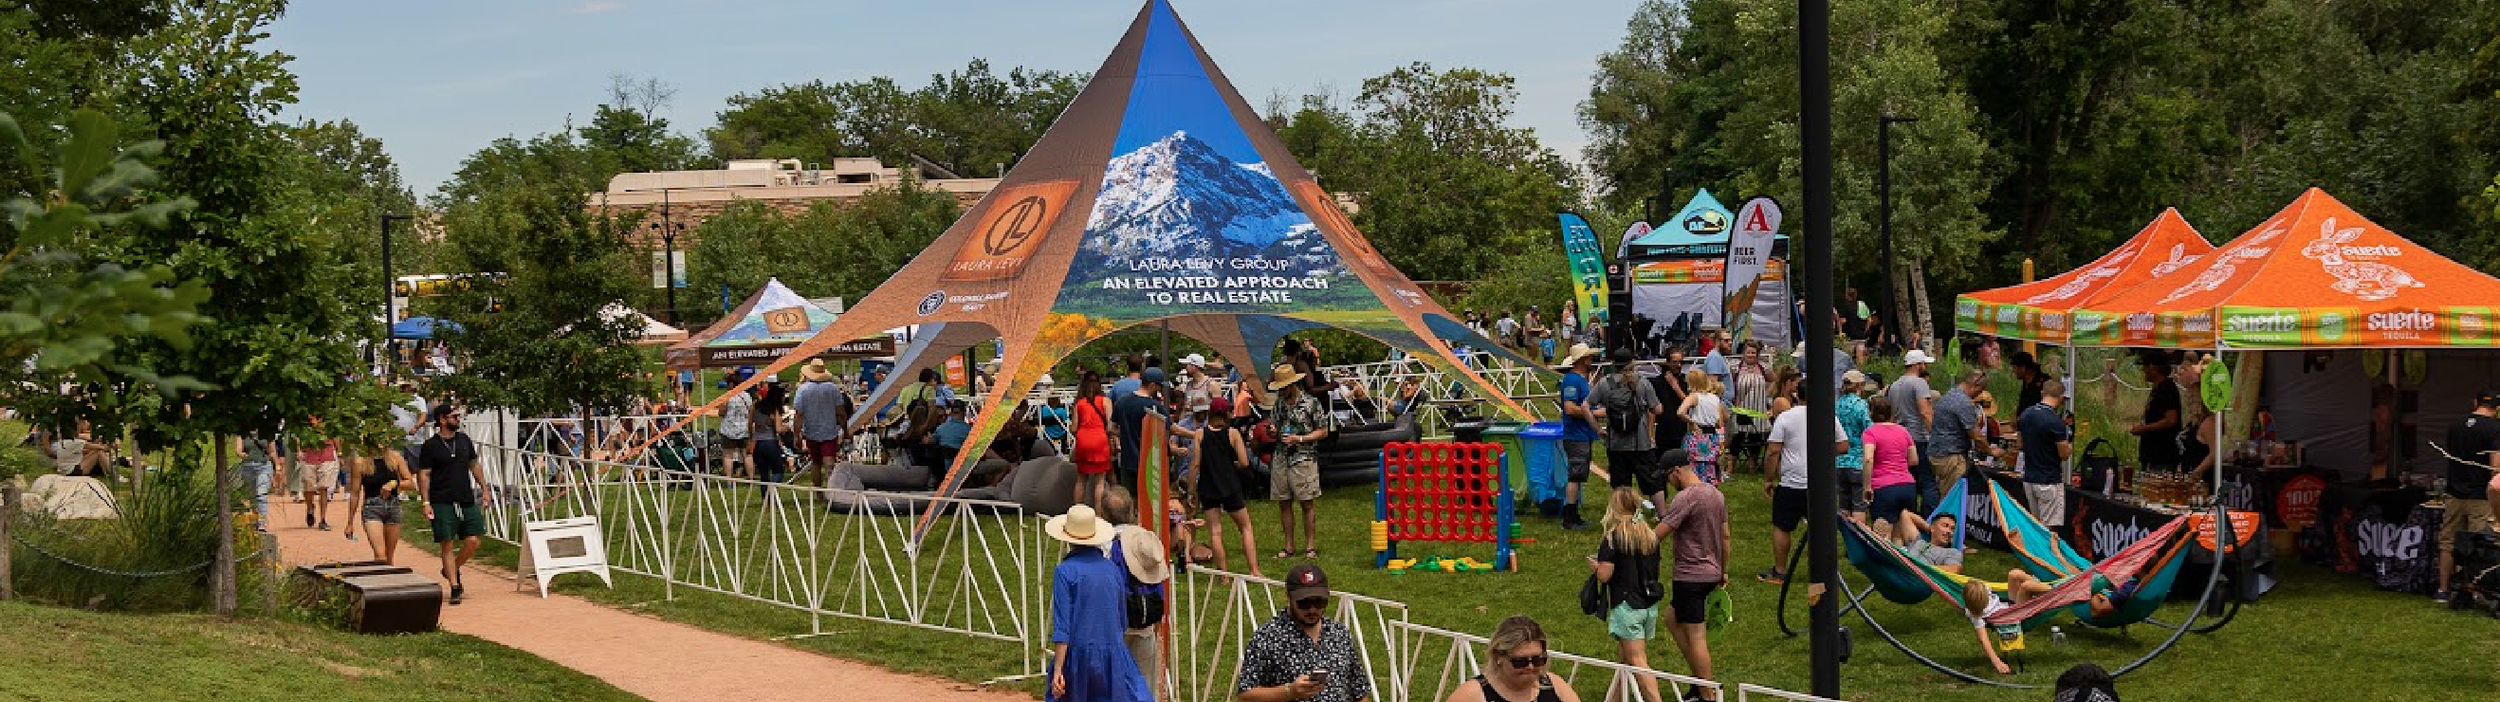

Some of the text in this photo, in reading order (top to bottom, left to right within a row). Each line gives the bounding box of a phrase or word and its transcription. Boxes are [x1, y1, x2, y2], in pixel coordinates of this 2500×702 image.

[1742, 202, 1773, 232] A
[1734, 246, 1756, 256] BEER
[952, 256, 1023, 272] LAURA LEVY
[1129, 257, 1290, 271] LAURA LEVY GROUP
[1103, 276, 1329, 290] AN ELEVATED APPROACH
[1146, 290, 1293, 305] TO REAL ESTATE
[2382, 332, 2420, 341] TEQUILA
[712, 350, 727, 360] AN
[728, 347, 768, 360] ELEVATED
[852, 342, 882, 352] ESTATE
